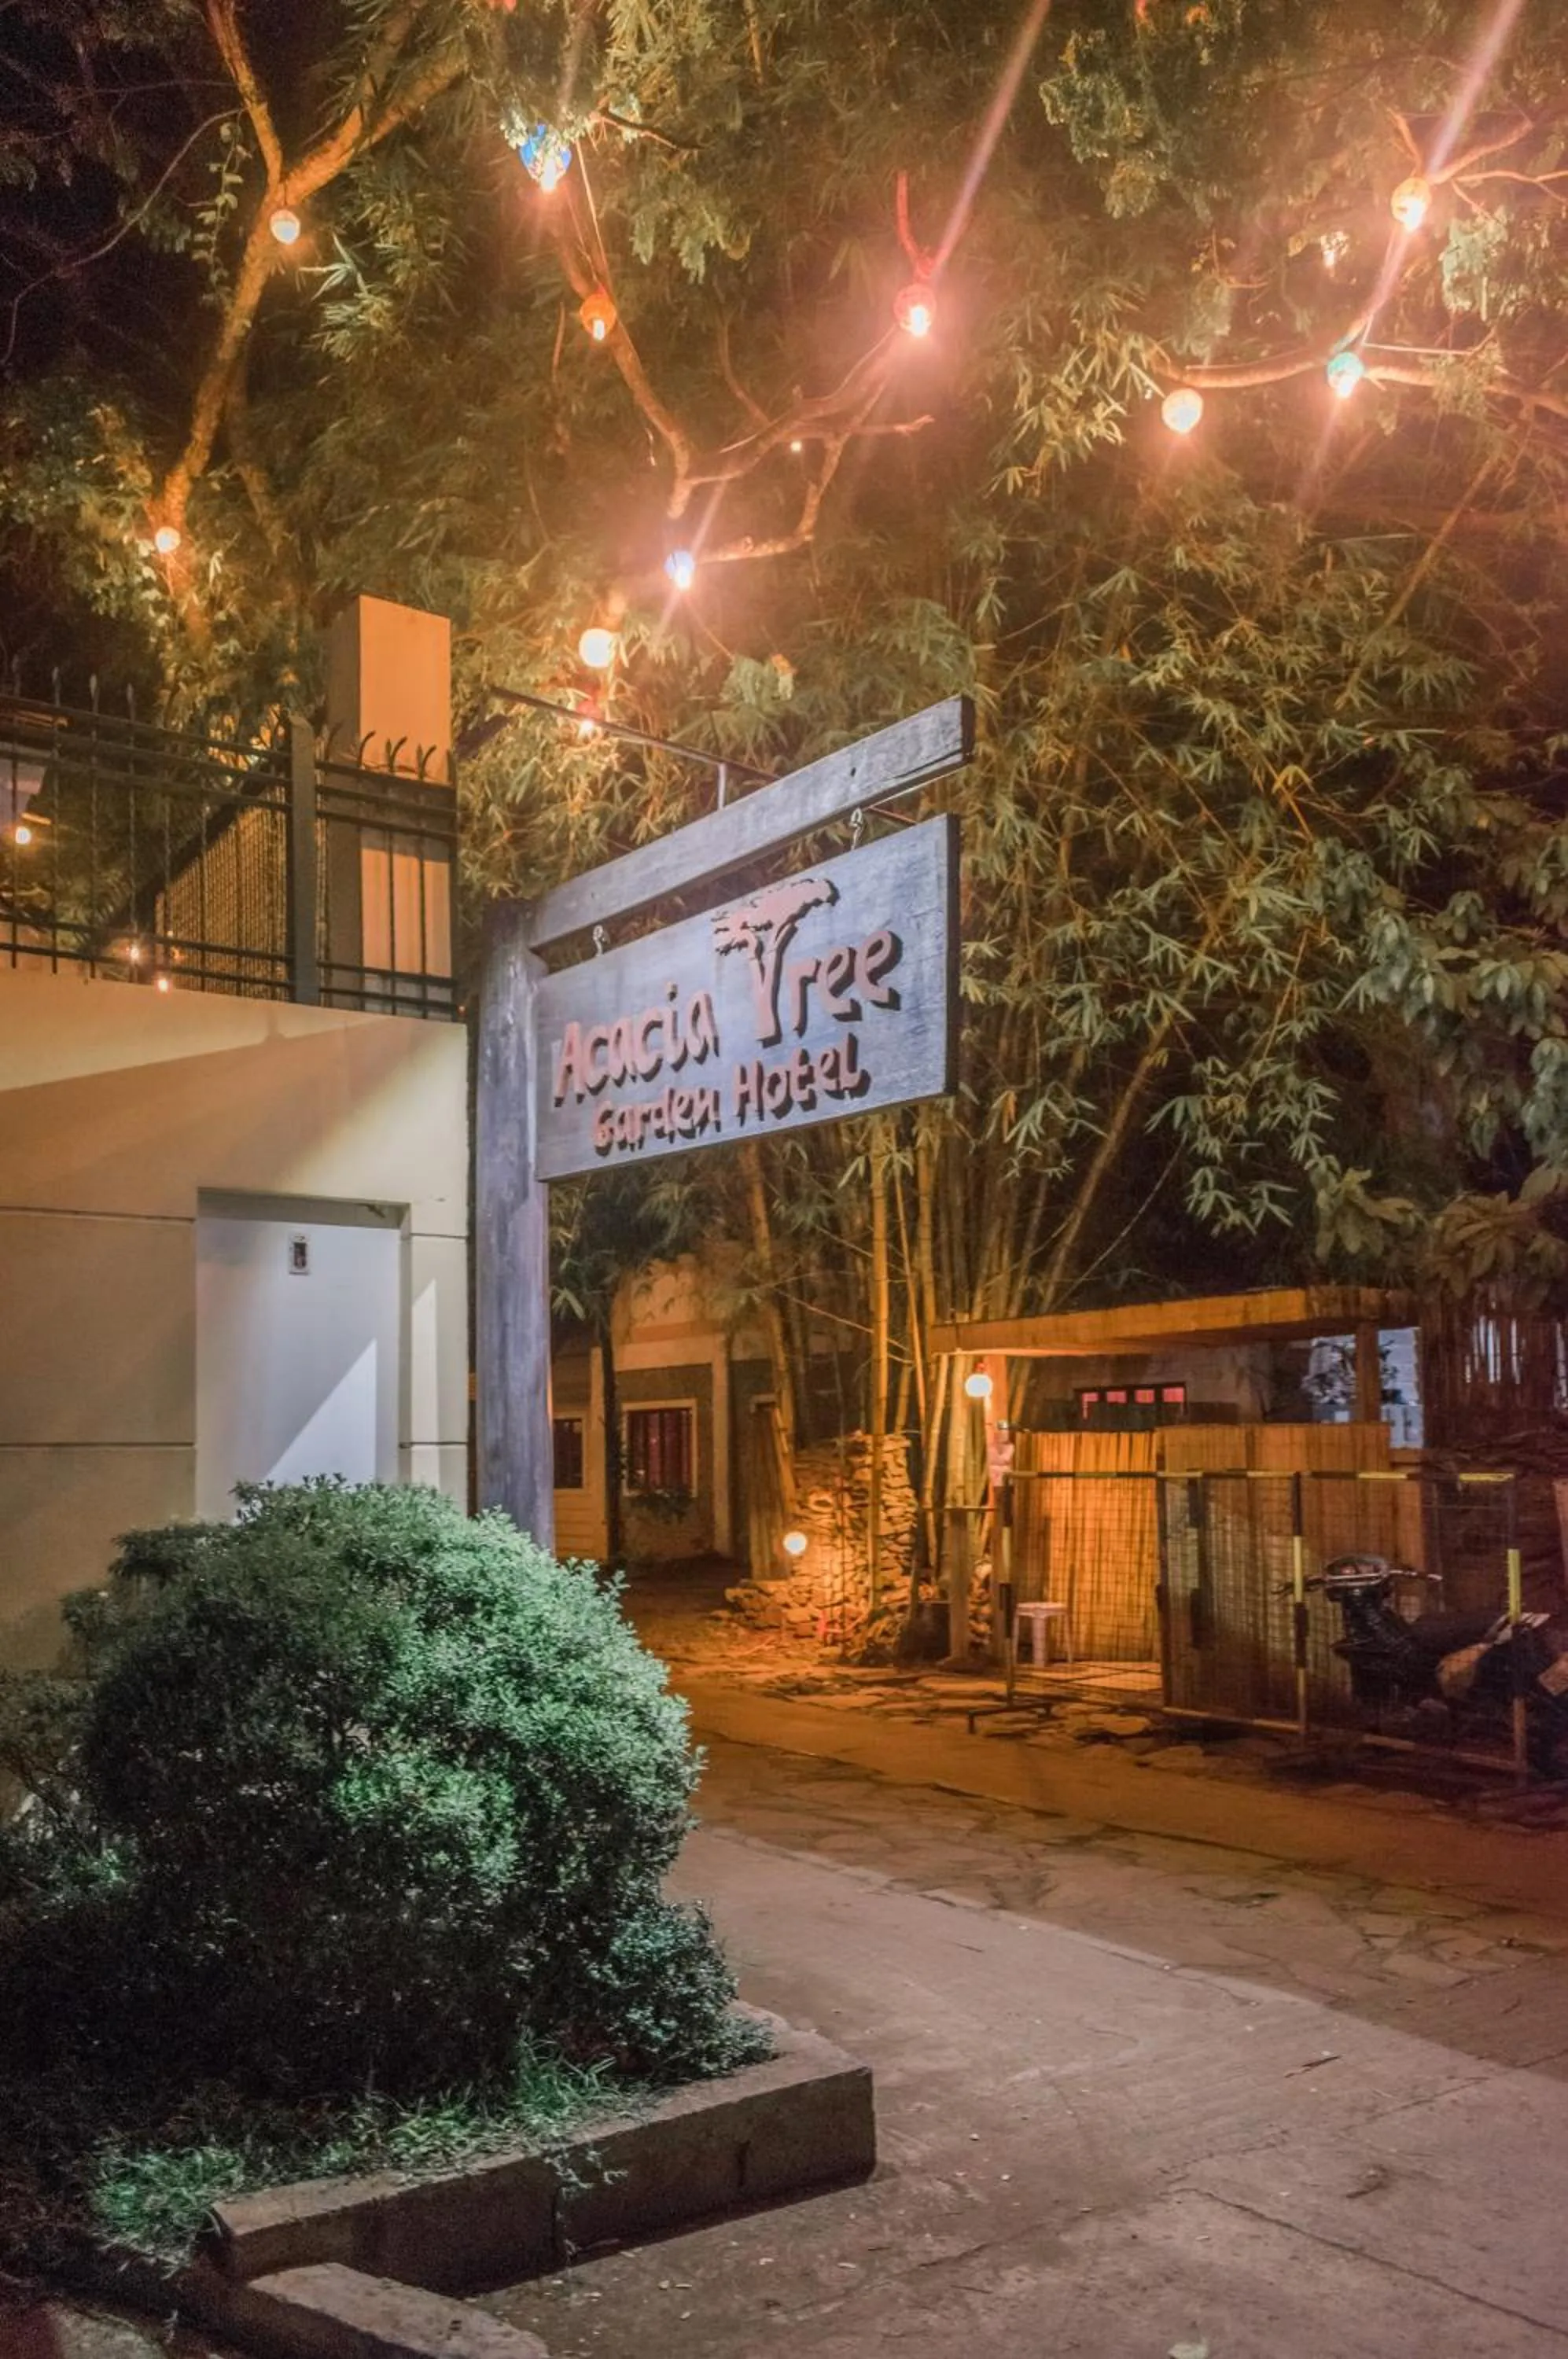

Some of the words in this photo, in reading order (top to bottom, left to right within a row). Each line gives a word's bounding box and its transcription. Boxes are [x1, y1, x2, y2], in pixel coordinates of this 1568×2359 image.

[554, 981, 720, 1107] Acacia
[711, 877, 904, 1048] Tree
[592, 1084, 721, 1157] Garden
